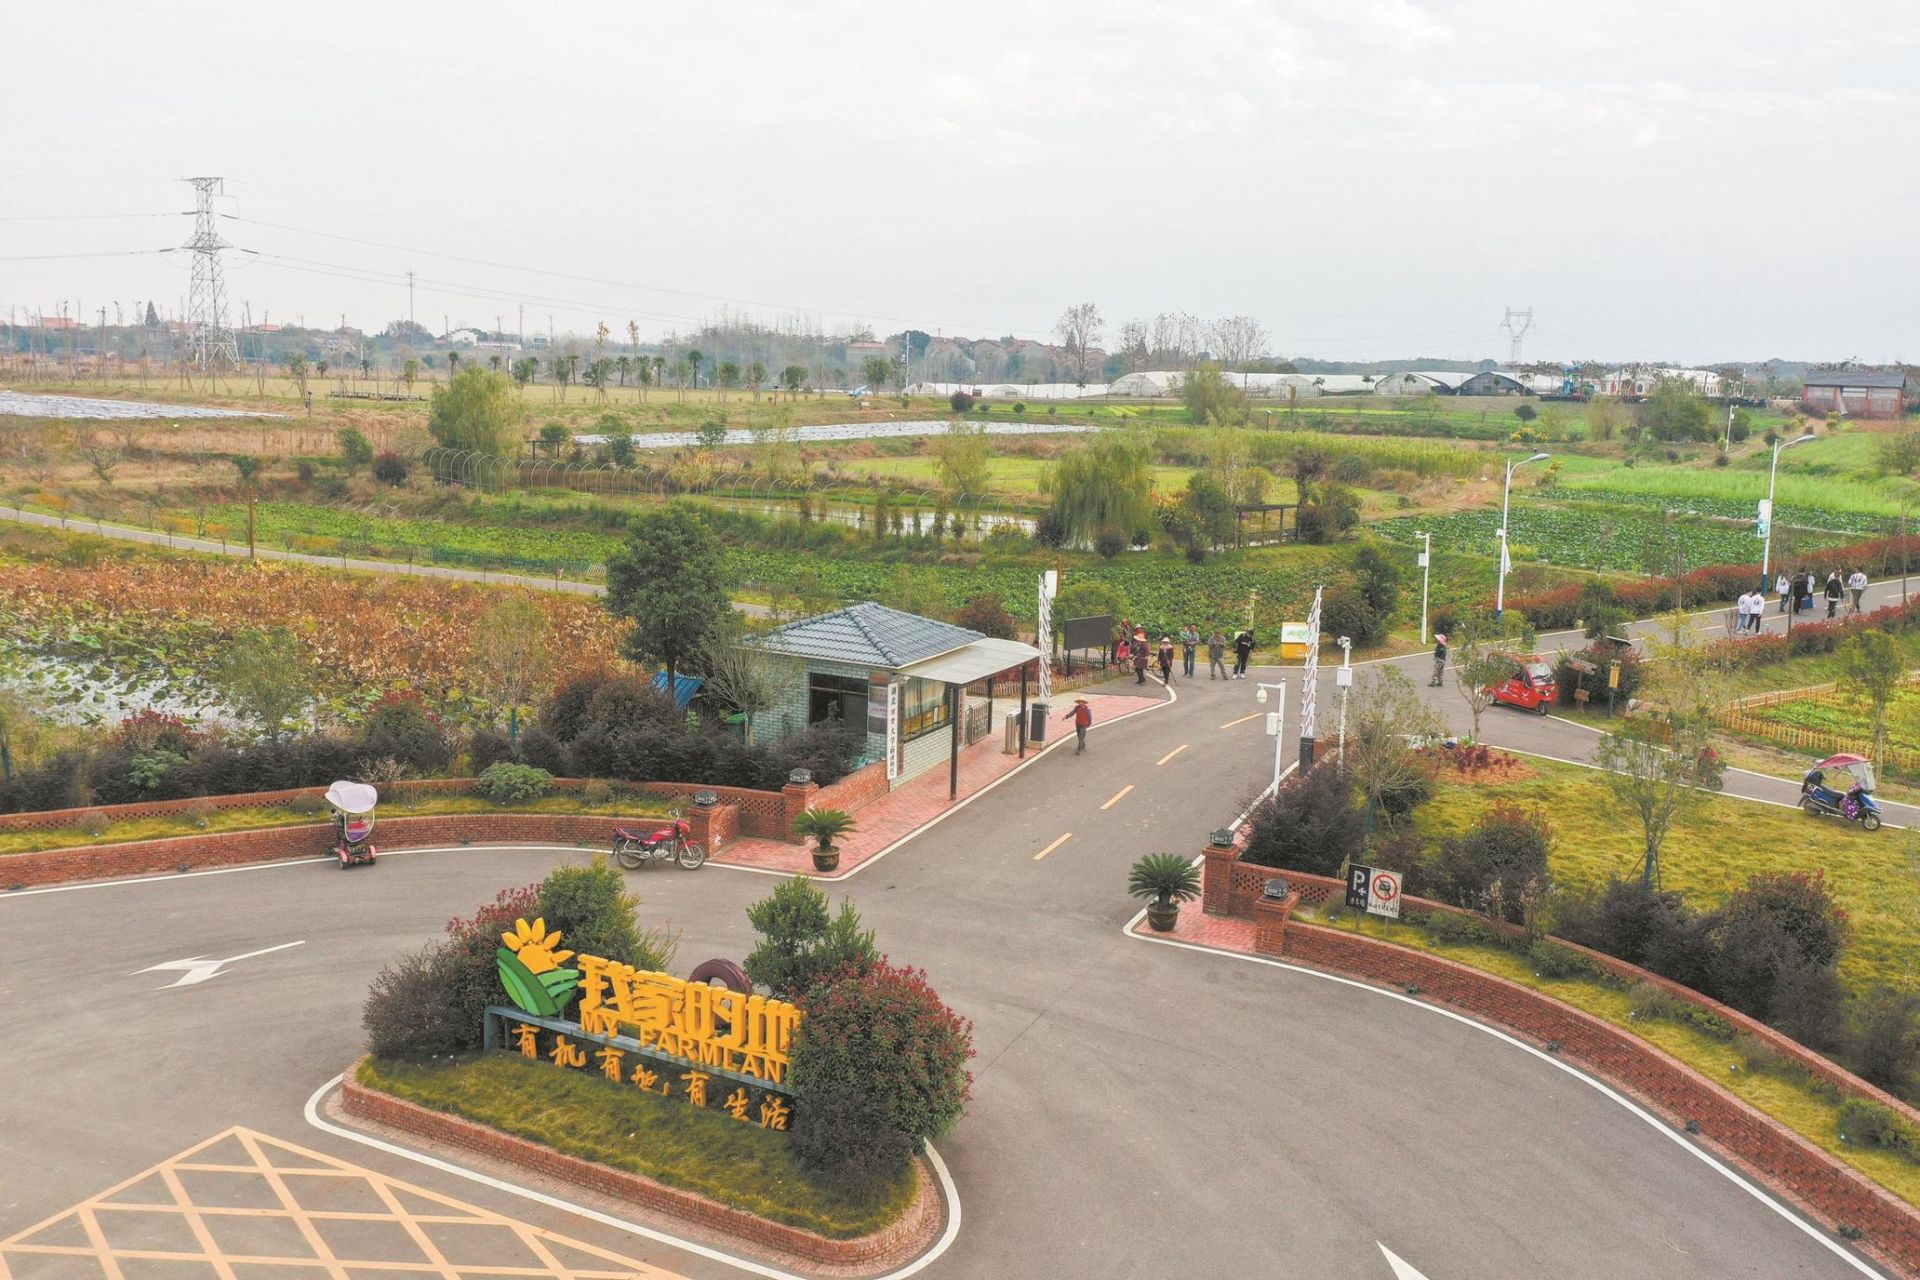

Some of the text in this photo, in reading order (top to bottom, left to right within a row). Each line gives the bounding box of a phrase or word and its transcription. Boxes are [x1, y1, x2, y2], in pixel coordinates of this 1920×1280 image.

[1353, 870, 1365, 891] P
[580, 1008, 783, 1085] MY FARMLAN
